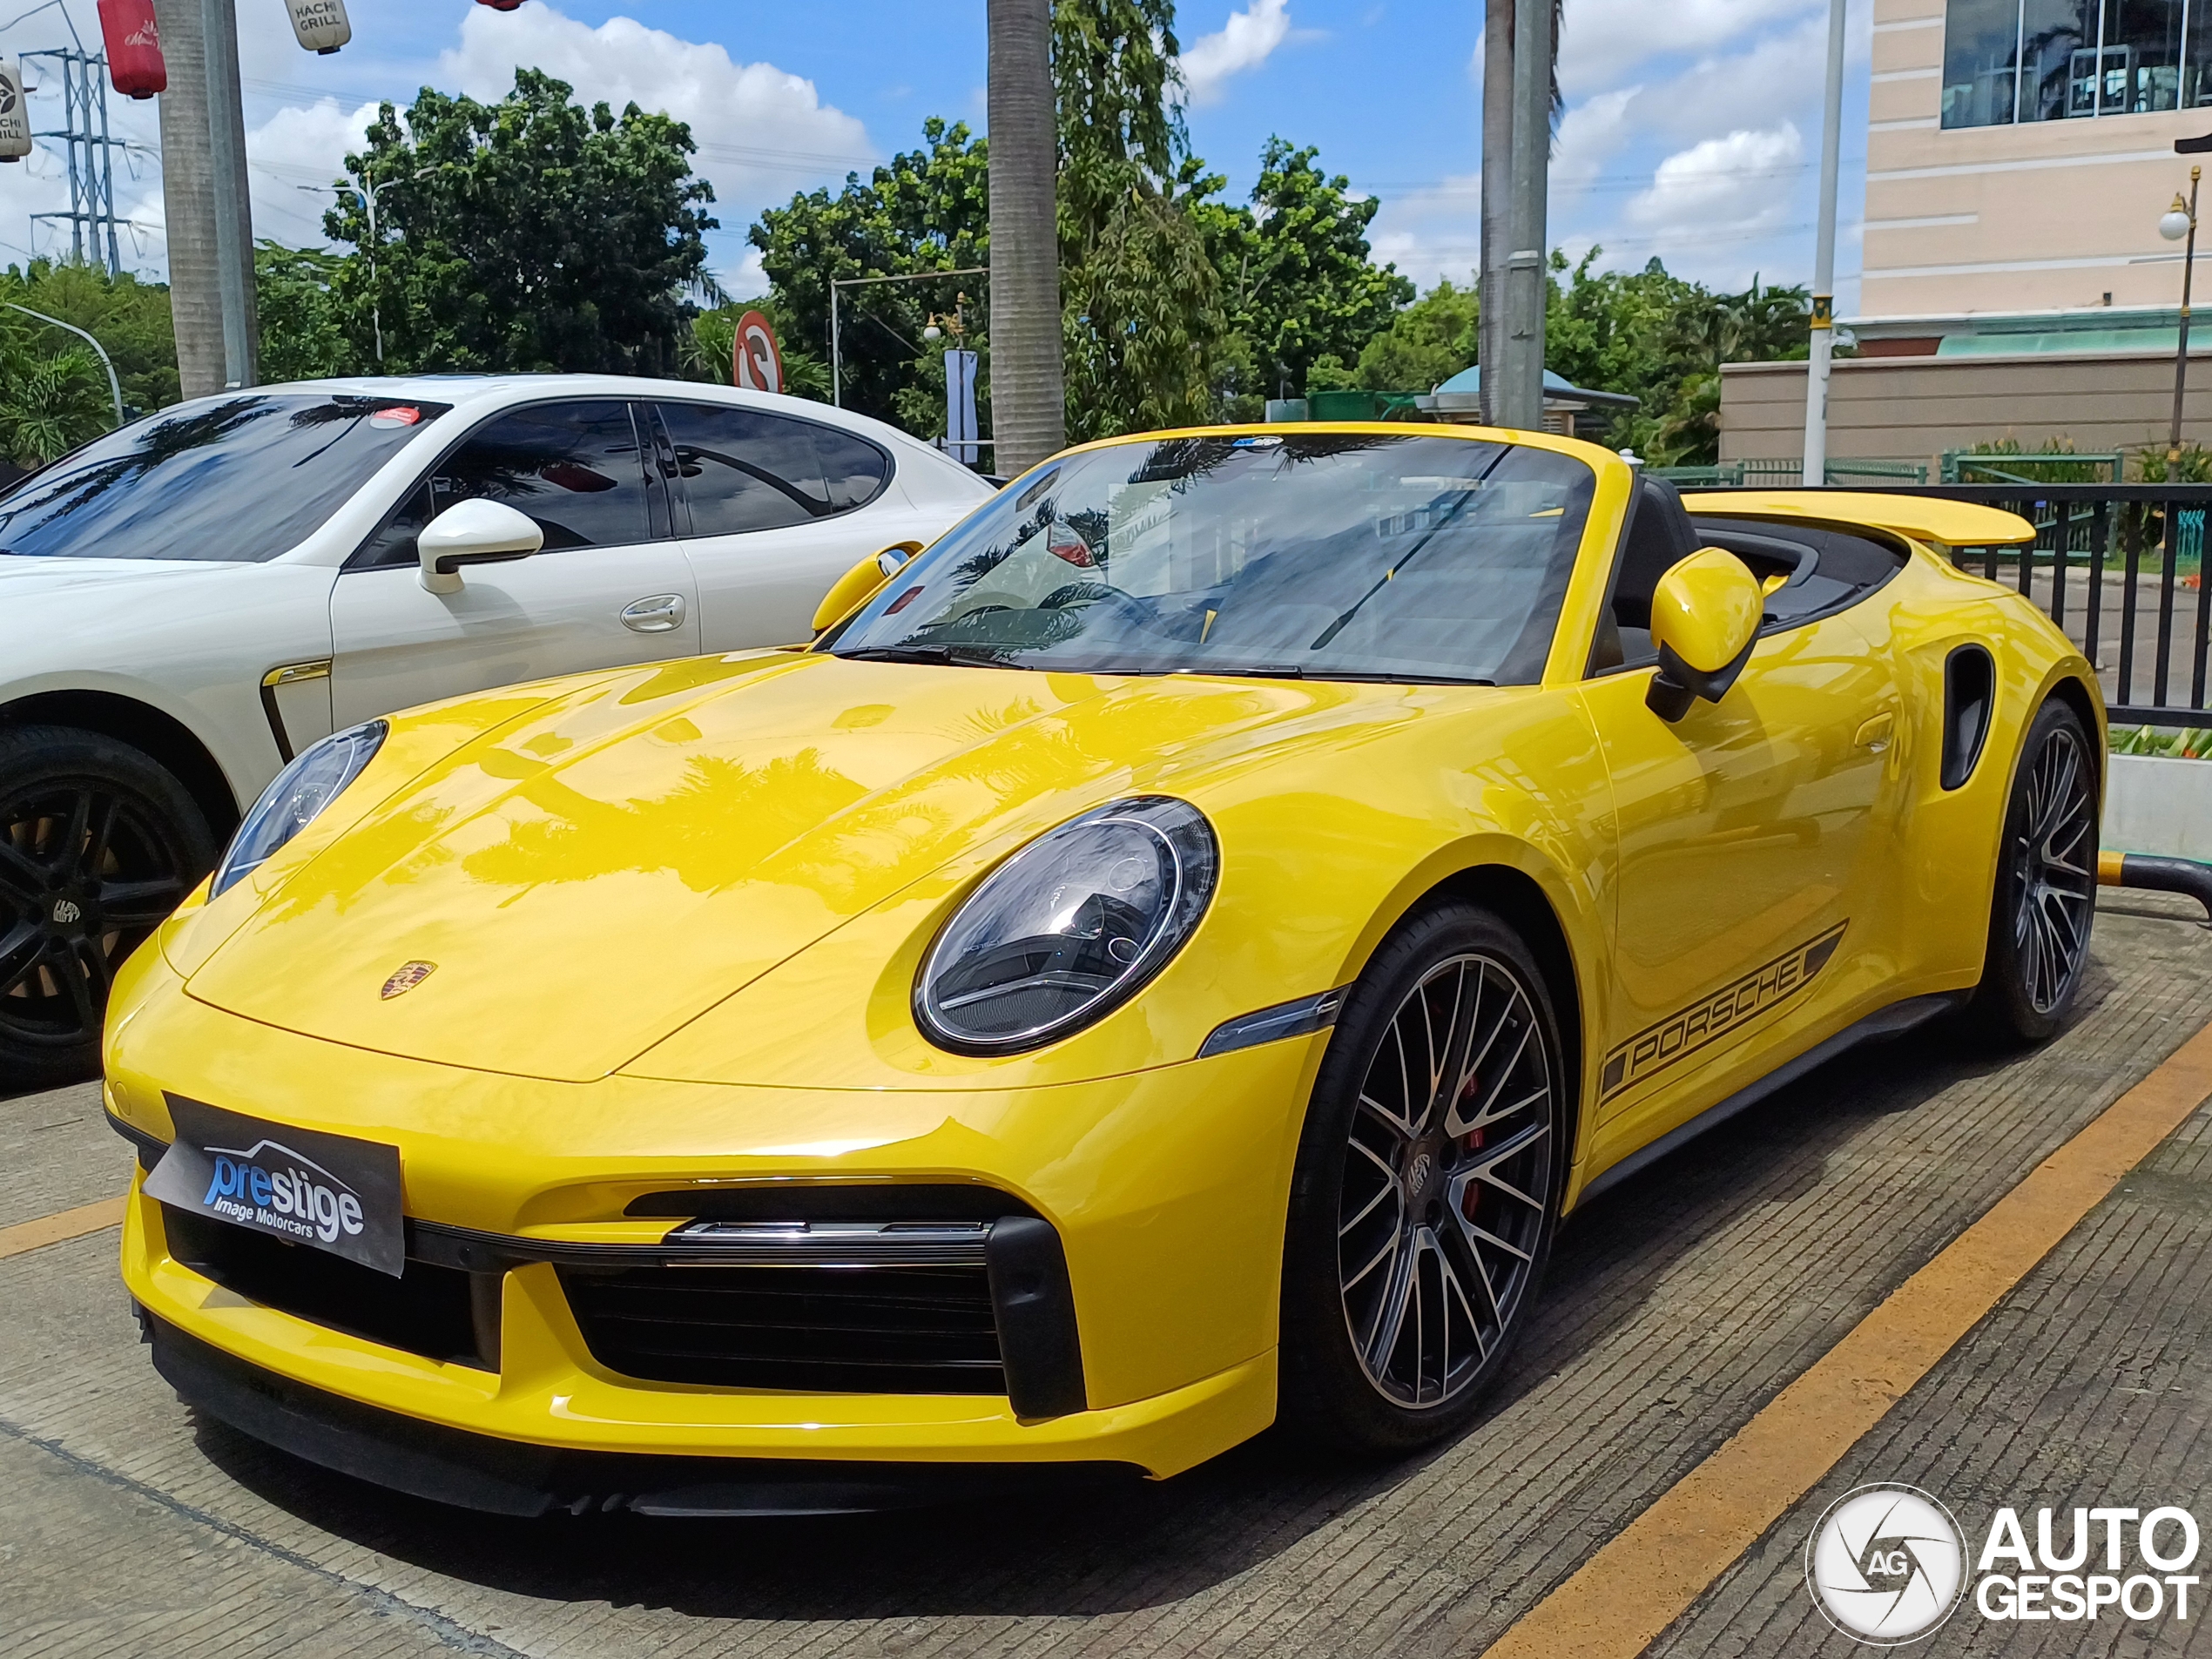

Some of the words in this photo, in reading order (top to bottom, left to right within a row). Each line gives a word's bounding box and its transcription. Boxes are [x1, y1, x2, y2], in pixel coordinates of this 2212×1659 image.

[295, 1, 337, 19] HACHI
[300, 14, 341, 31] GRILL
[1630, 954, 1800, 1076] PORSCHE
[204, 1155, 364, 1243] prestige
[213, 1197, 254, 1223] Image
[256, 1207, 314, 1238] Motorcars
